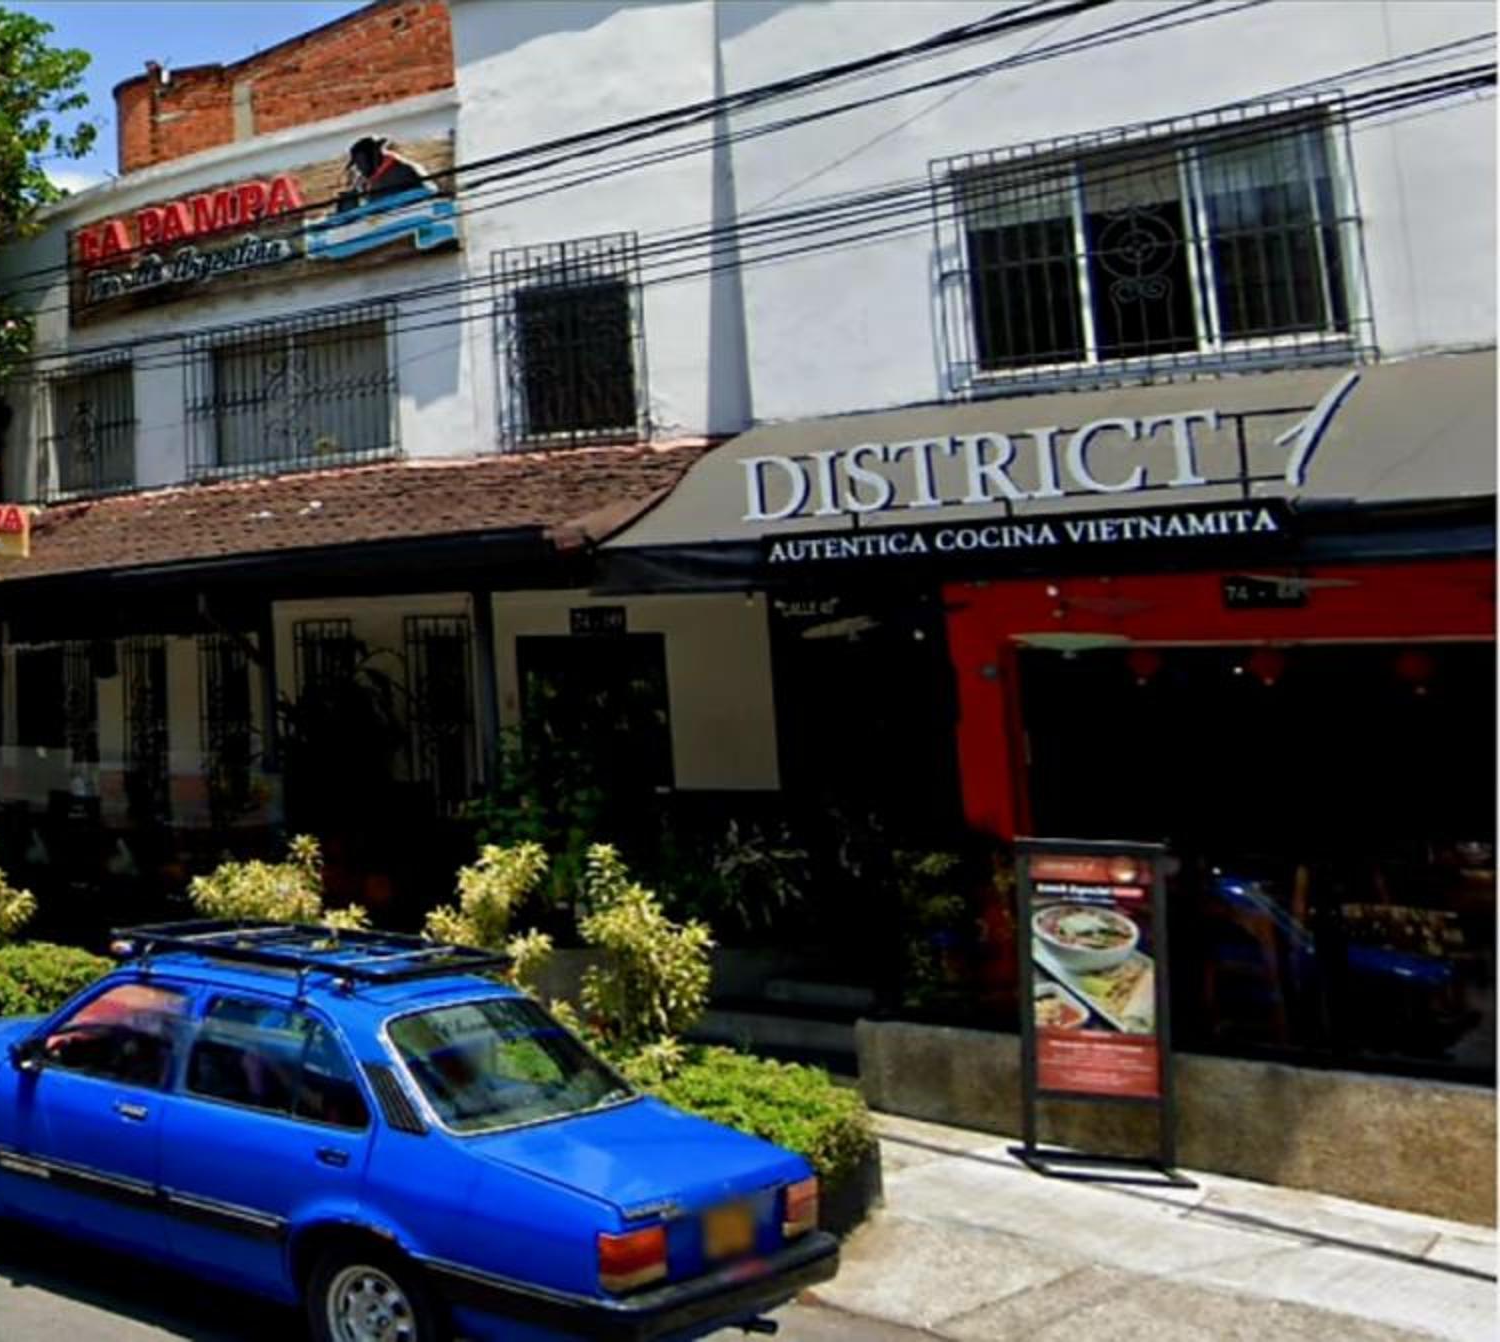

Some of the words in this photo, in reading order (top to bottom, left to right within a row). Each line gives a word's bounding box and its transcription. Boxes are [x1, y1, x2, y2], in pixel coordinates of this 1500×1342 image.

[76, 218, 132, 261] LA
[135, 173, 307, 244] PAMPA
[740, 408, 1224, 522] DISTRICT
[1274, 371, 1361, 487] 1
[767, 531, 928, 563] AUTENTICA
[934, 521, 1058, 552] COCINA
[1063, 508, 1279, 545] VIETNAMITA
